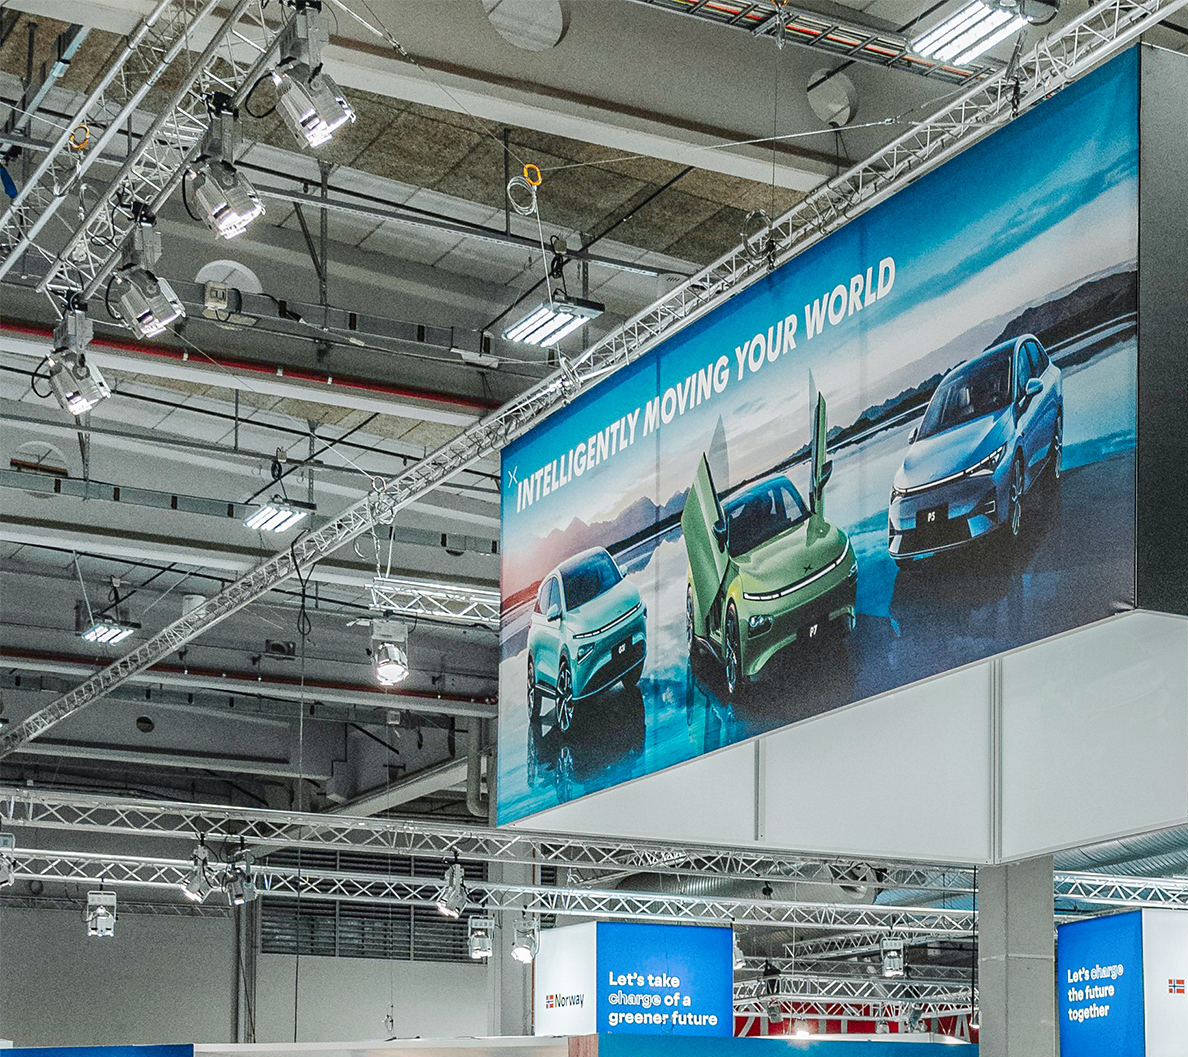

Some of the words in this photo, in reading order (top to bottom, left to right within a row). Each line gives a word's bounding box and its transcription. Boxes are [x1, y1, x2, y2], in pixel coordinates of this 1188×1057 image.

[516, 407, 640, 513] INTELLIGENTLY
[643, 355, 730, 437] MOVING
[735, 314, 798, 381] YOUR
[804, 256, 896, 340] WORLD
[608, 971, 645, 986] Let's
[647, 973, 680, 988] take
[1067, 967, 1090, 983] Let's
[1090, 964, 1124, 980] charge
[554, 993, 585, 1009] Norway
[608, 990, 661, 1008] charge
[664, 992, 681, 1006] of
[682, 995, 691, 1006] a
[1068, 987, 1084, 1002] the
[1085, 985, 1115, 1000] future
[608, 1011, 668, 1026] greener
[672, 1010, 718, 1025] future
[1068, 1003, 1110, 1023] together
